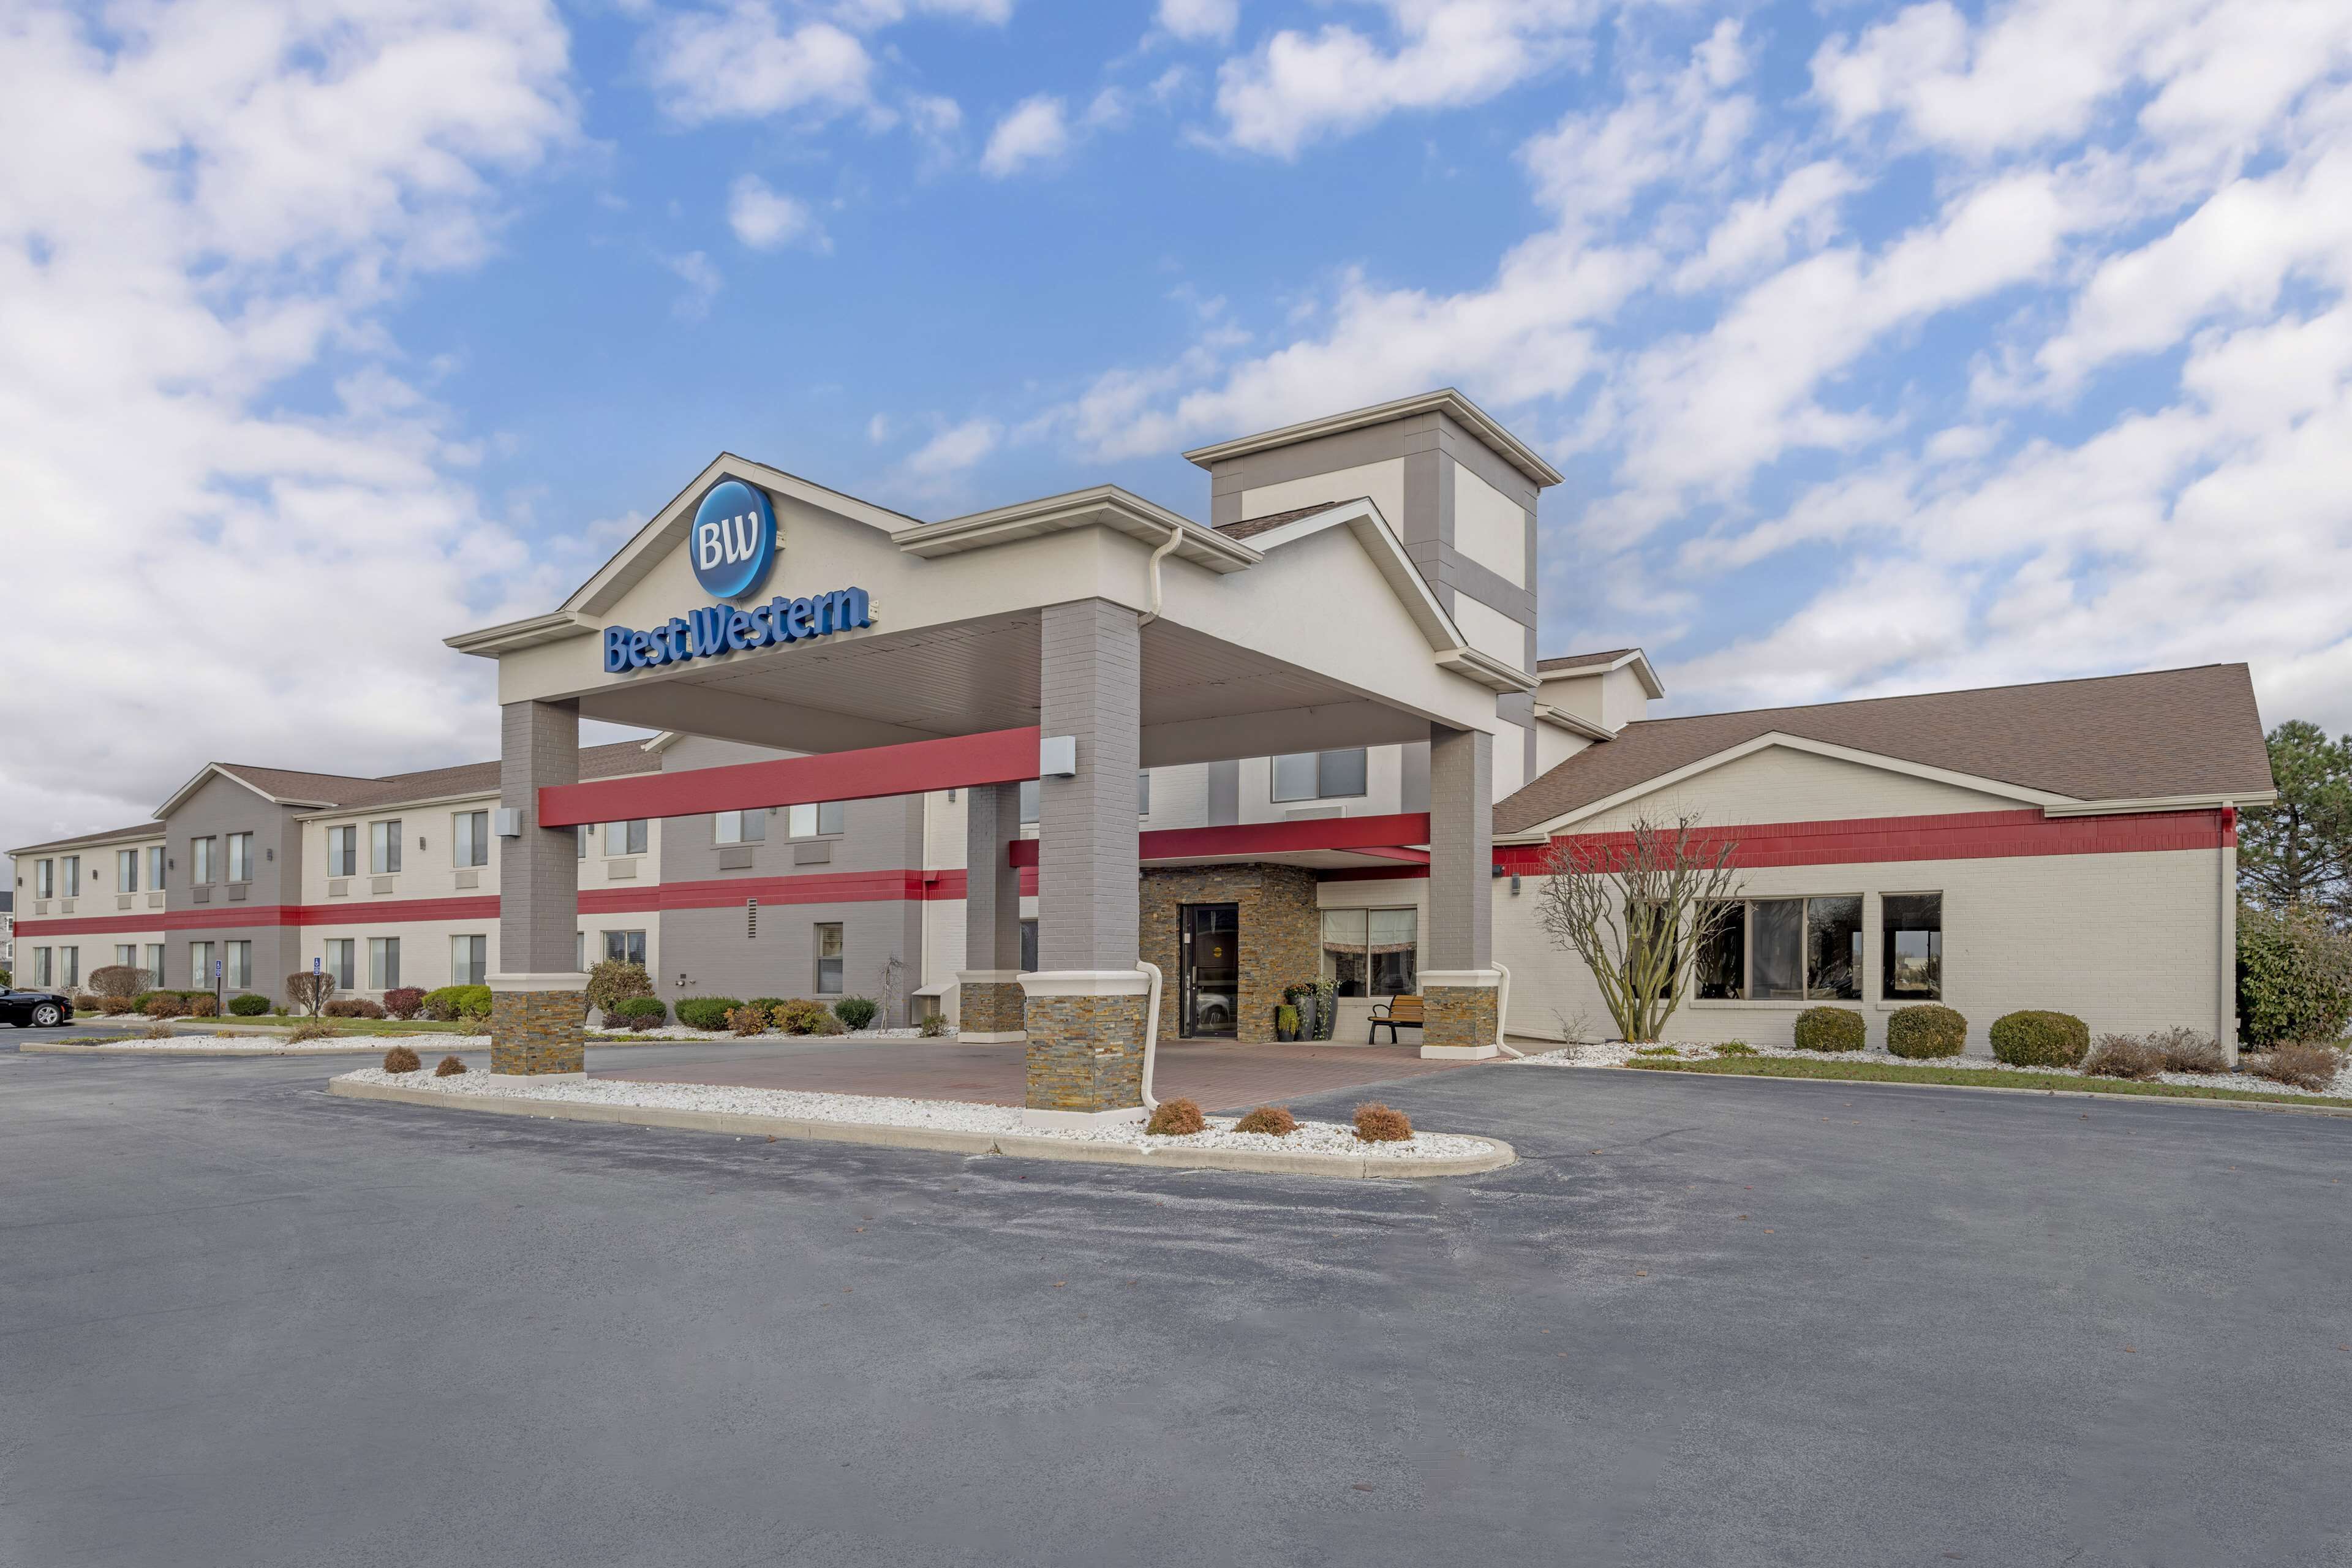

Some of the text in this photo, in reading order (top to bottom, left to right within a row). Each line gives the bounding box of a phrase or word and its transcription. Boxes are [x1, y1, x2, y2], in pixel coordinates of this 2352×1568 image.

[698, 511, 759, 570] BW
[604, 586, 871, 673] Best Western
